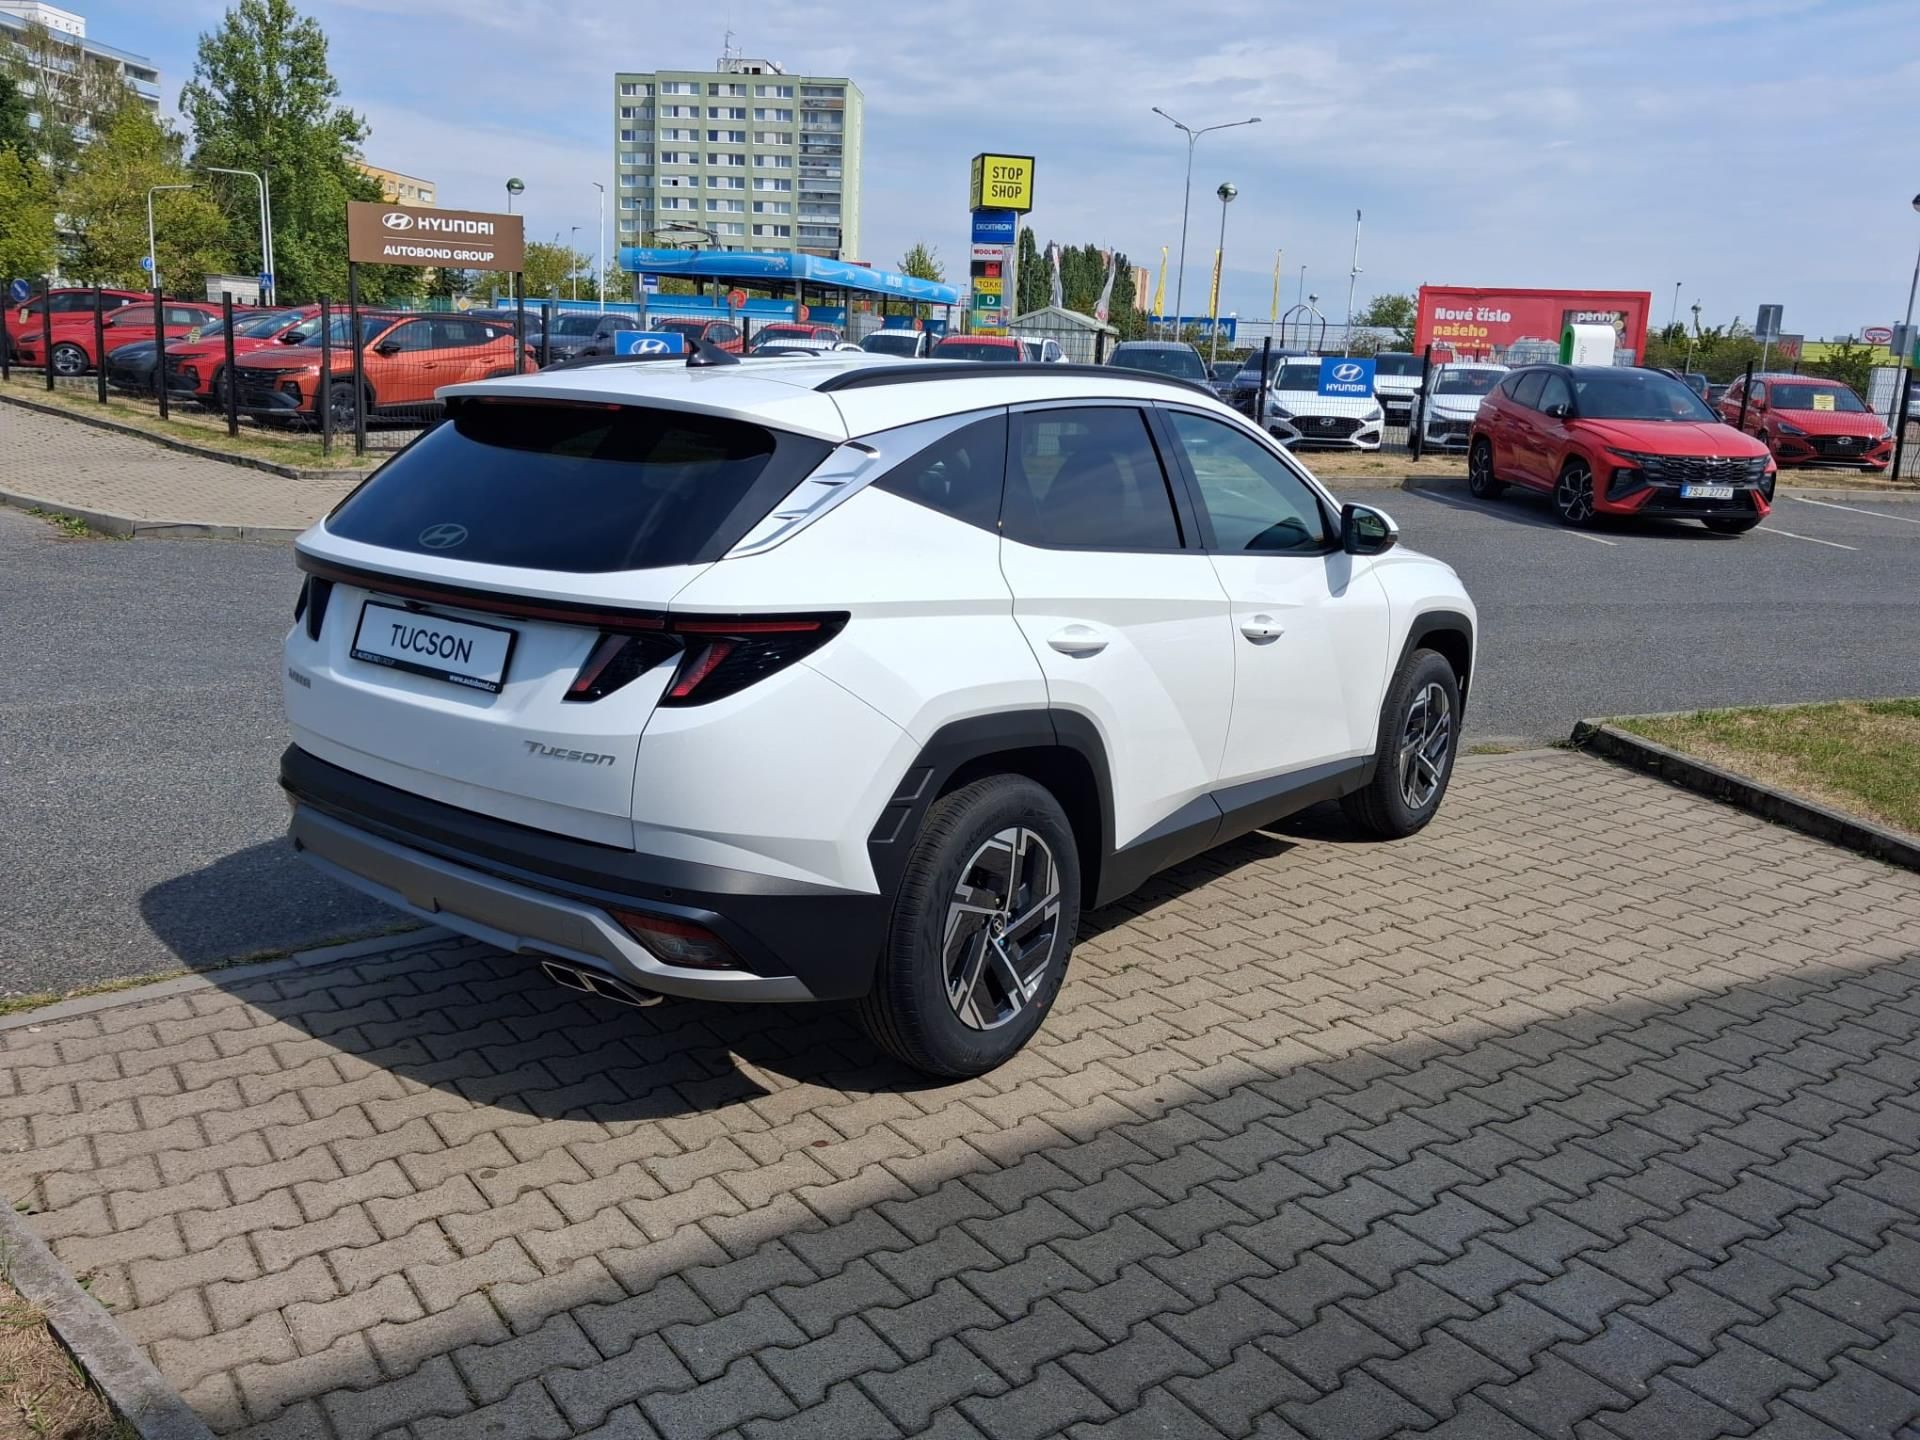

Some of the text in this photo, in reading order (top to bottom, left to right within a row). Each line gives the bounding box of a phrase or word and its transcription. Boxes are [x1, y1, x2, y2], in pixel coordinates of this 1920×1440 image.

[992, 166, 1023, 180] STOP
[991, 184, 1022, 199] SHOP
[417, 217, 494, 235] HYUNDAI
[976, 223, 1012, 231] DECATHLON
[383, 245, 495, 262] AUTOBOND GROUP
[1434, 307, 1512, 323] Nové číslo
[1577, 311, 1619, 323] penny
[1432, 322, 1489, 338] našeho
[1326, 383, 1367, 393] HYUNDAI
[391, 623, 473, 664] TUCSON
